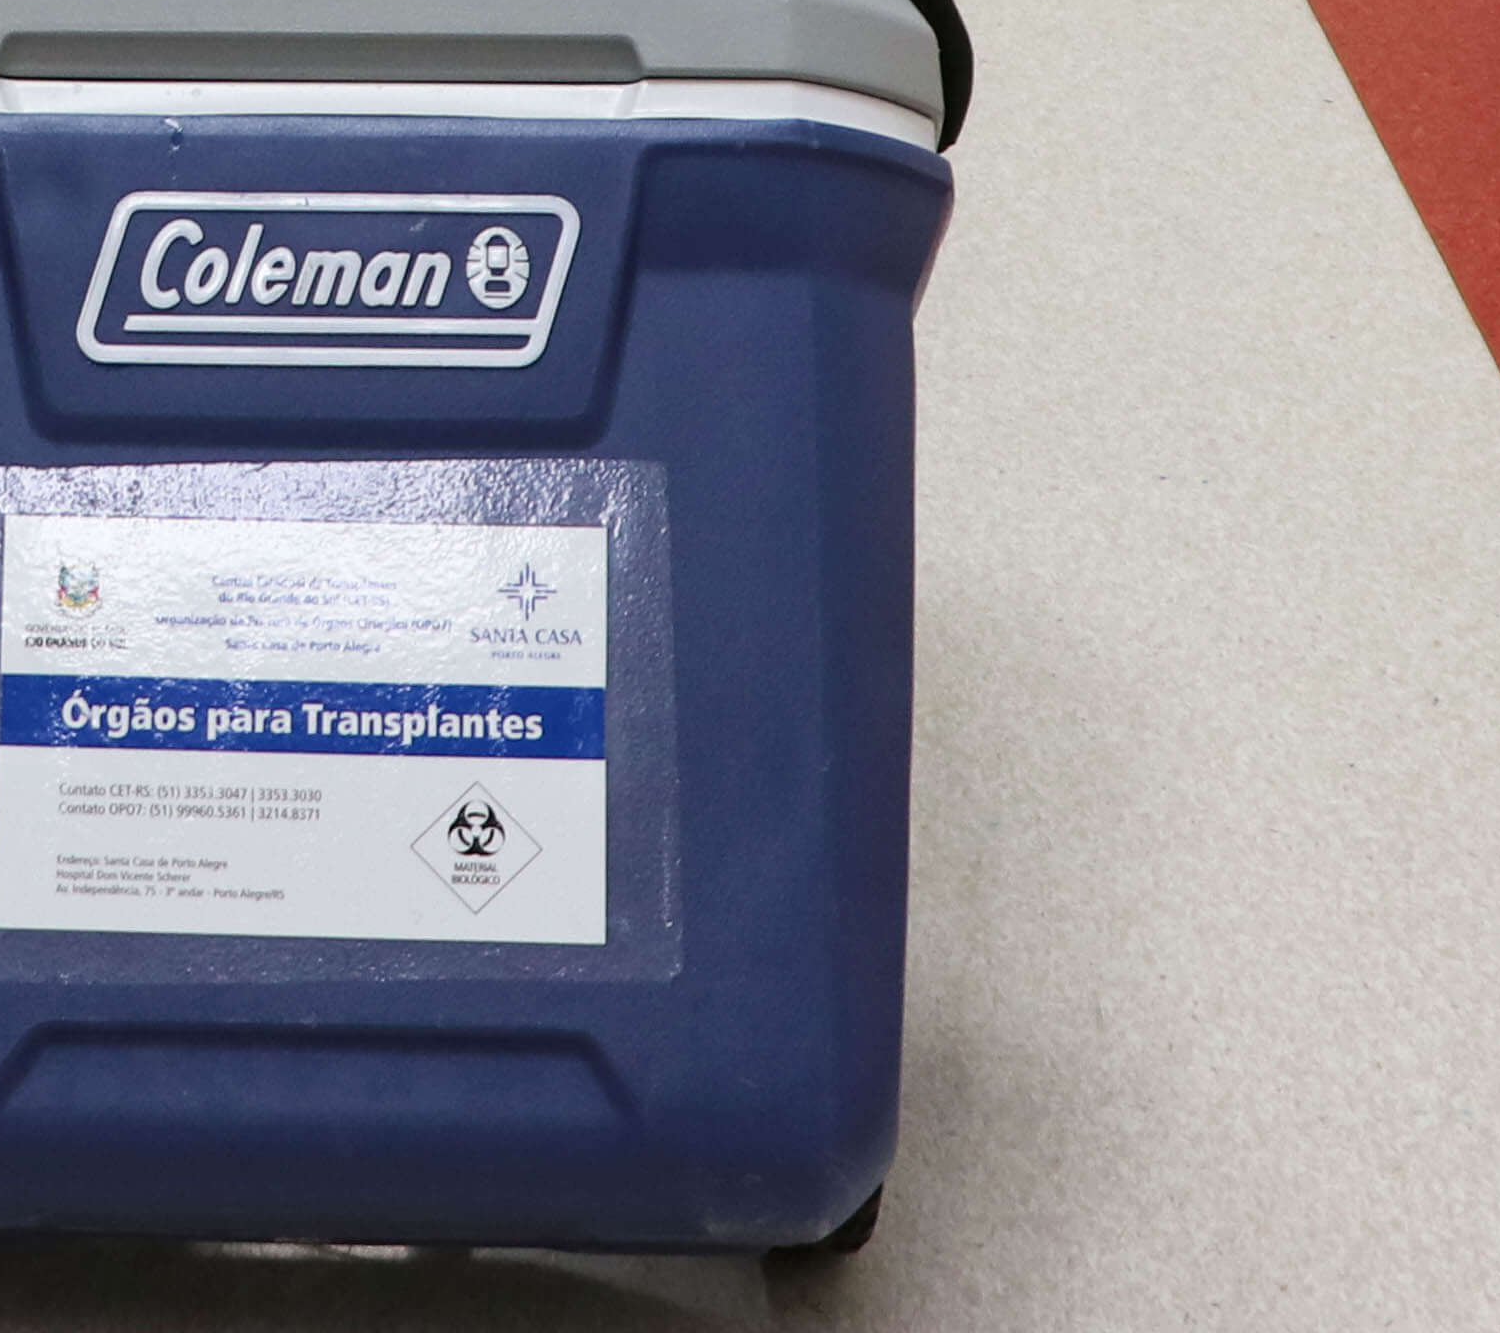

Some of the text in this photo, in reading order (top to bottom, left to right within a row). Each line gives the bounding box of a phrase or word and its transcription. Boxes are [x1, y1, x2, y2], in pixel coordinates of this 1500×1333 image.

[140, 218, 452, 310] Coleman
[470, 627, 583, 645] SANTA CASA
[61, 689, 544, 746] Órgãos para Transplantes
[58, 783, 106, 797] Contato
[158, 784, 181, 801] (51)
[257, 787, 322, 803] 3353.3030
[57, 801, 106, 815] Contato
[149, 803, 173, 820] (51)
[257, 806, 321, 822] 3214.8371
[104, 855, 130, 866] Santa
[132, 855, 155, 867] Casa
[157, 855, 170, 867] de
[171, 856, 197, 868] Porto
[198, 856, 229, 870] Alegre
[454, 862, 497, 872] MATERIAL
[56, 869, 94, 881] Hospital
[96, 869, 118, 880] Dom
[120, 870, 154, 882] Vicente
[452, 873, 500, 885] BIOLÓGICO
[213, 887, 239, 900] Porto
